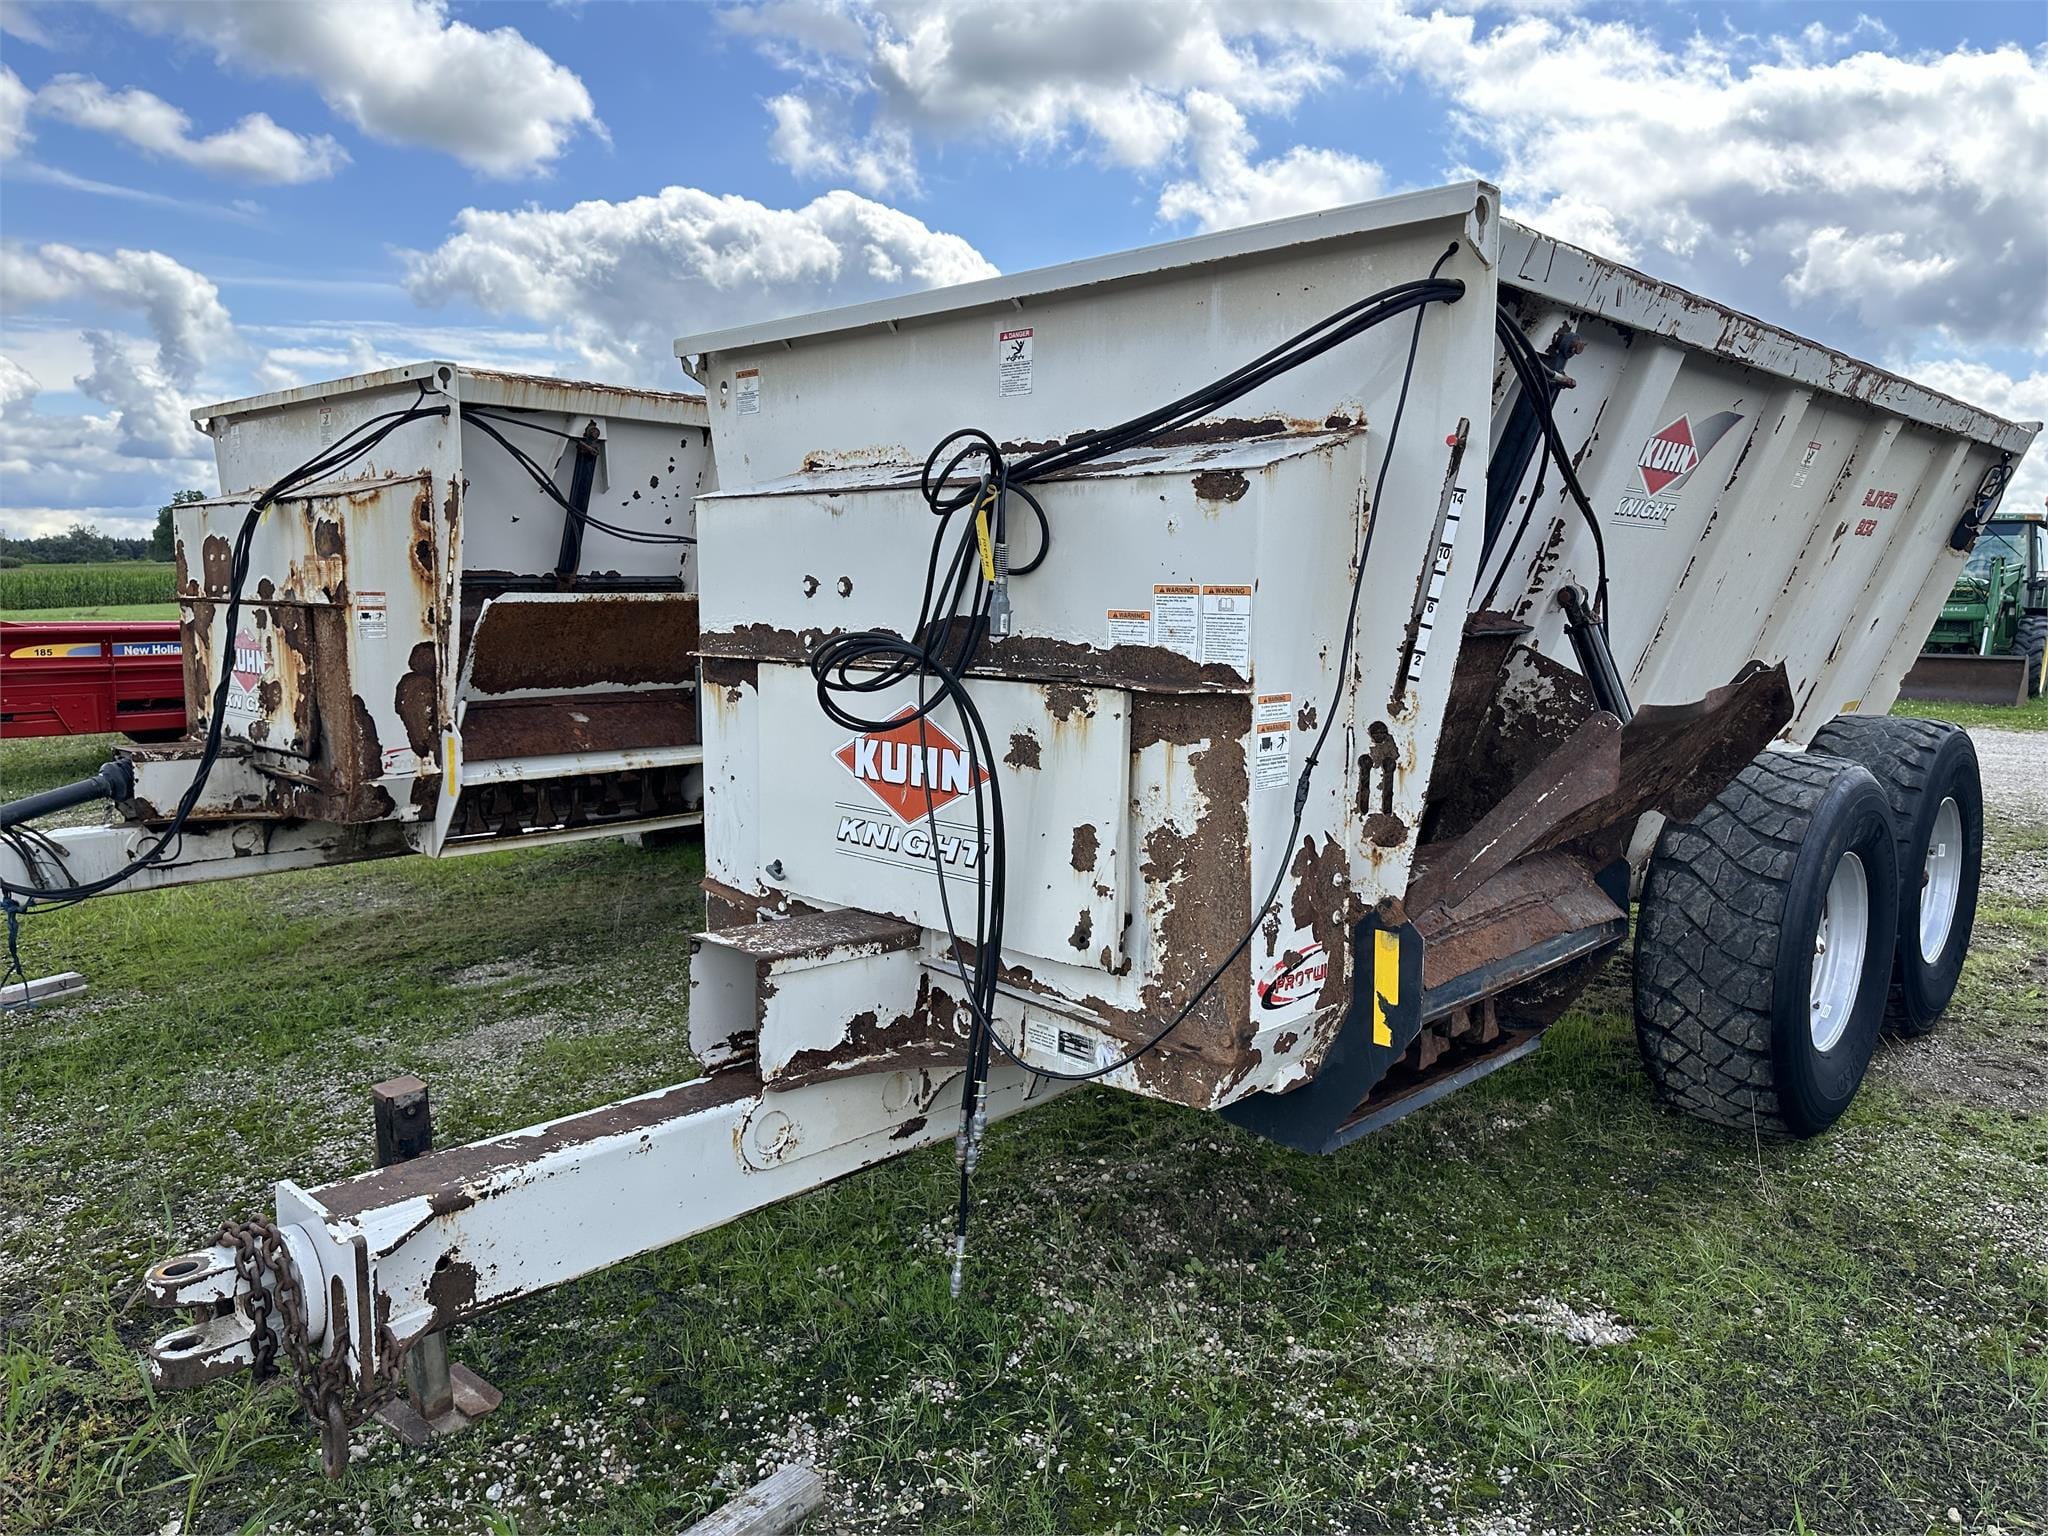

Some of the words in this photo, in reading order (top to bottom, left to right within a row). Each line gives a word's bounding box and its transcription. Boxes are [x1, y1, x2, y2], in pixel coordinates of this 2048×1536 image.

[1638, 436, 1697, 475] KUHN
[1452, 493, 1464, 505] 14
[1614, 496, 1677, 521] KNIGHT
[1438, 547, 1450, 560] 10
[1215, 587, 1246, 595] WARNING
[1427, 602, 1435, 614] 6
[1119, 612, 1145, 620] WARNING
[33, 648, 53, 657] 185
[123, 645, 150, 655] New
[233, 648, 266, 675] UHN
[1414, 655, 1421, 667] 2
[854, 737, 971, 795] KUHN
[837, 816, 990, 868] KNIGHT
